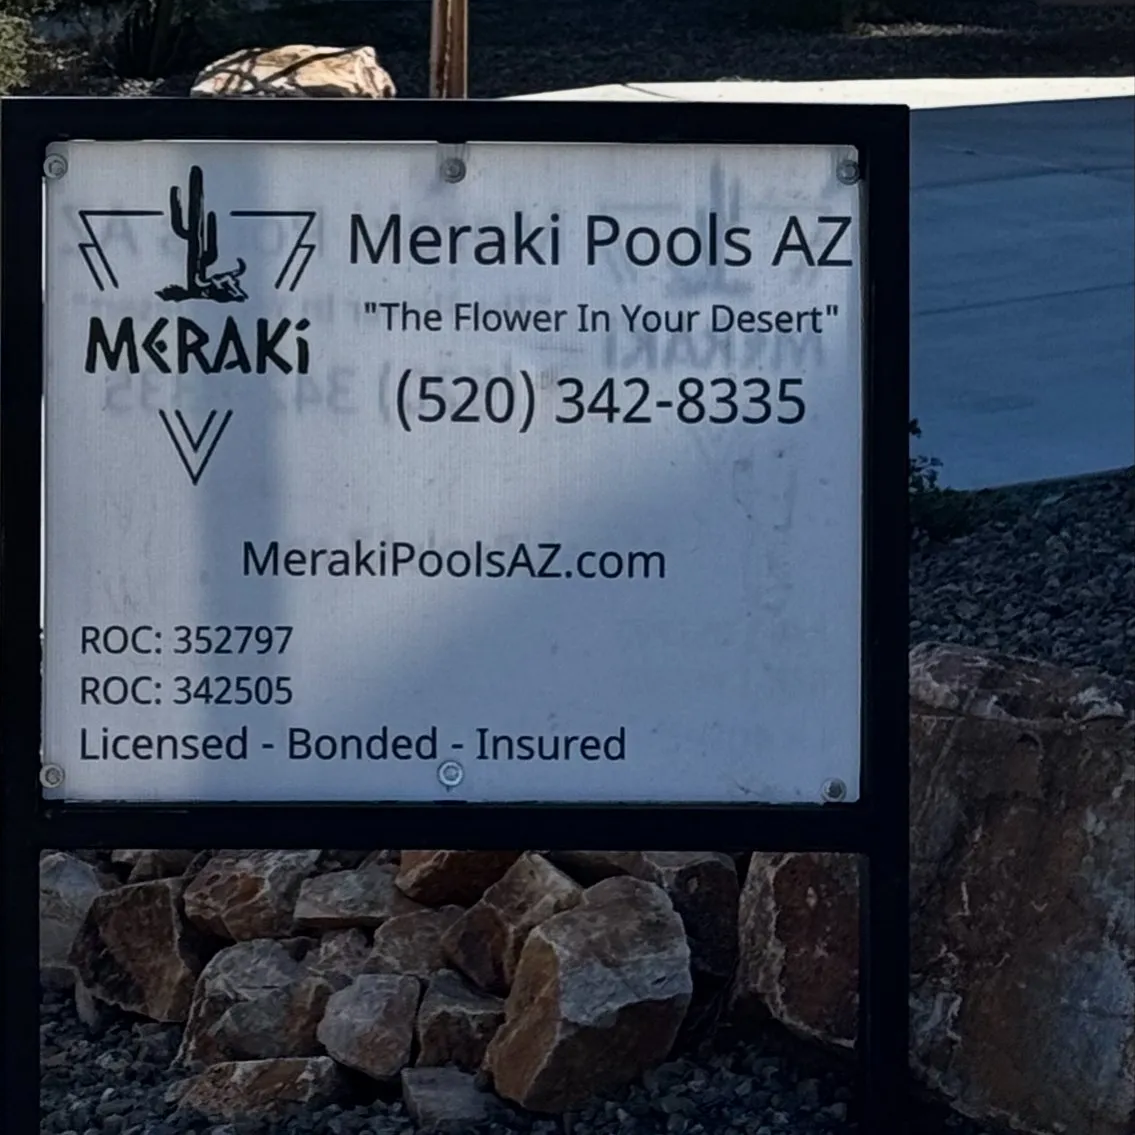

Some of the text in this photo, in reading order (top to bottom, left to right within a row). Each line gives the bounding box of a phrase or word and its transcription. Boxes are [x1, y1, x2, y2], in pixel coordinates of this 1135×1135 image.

[350, 210, 561, 267] Meraki
[586, 211, 753, 268] Pools
[771, 214, 854, 268] AZ
[363, 300, 444, 333] "The
[453, 300, 569, 334] Flower
[577, 303, 611, 334] In
[620, 303, 702, 335] Your
[710, 304, 840, 335] Desert"
[395, 367, 536, 434] (520)
[555, 376, 807, 426] 342-8335
[242, 539, 667, 580] MerakiPoolsAZ.com
[80, 625, 295, 656] ROC: 352797
[80, 675, 294, 706] ROC: 342505
[79, 725, 249, 762] Licensed
[289, 725, 439, 762] Bonded
[476, 726, 626, 762] Insured
